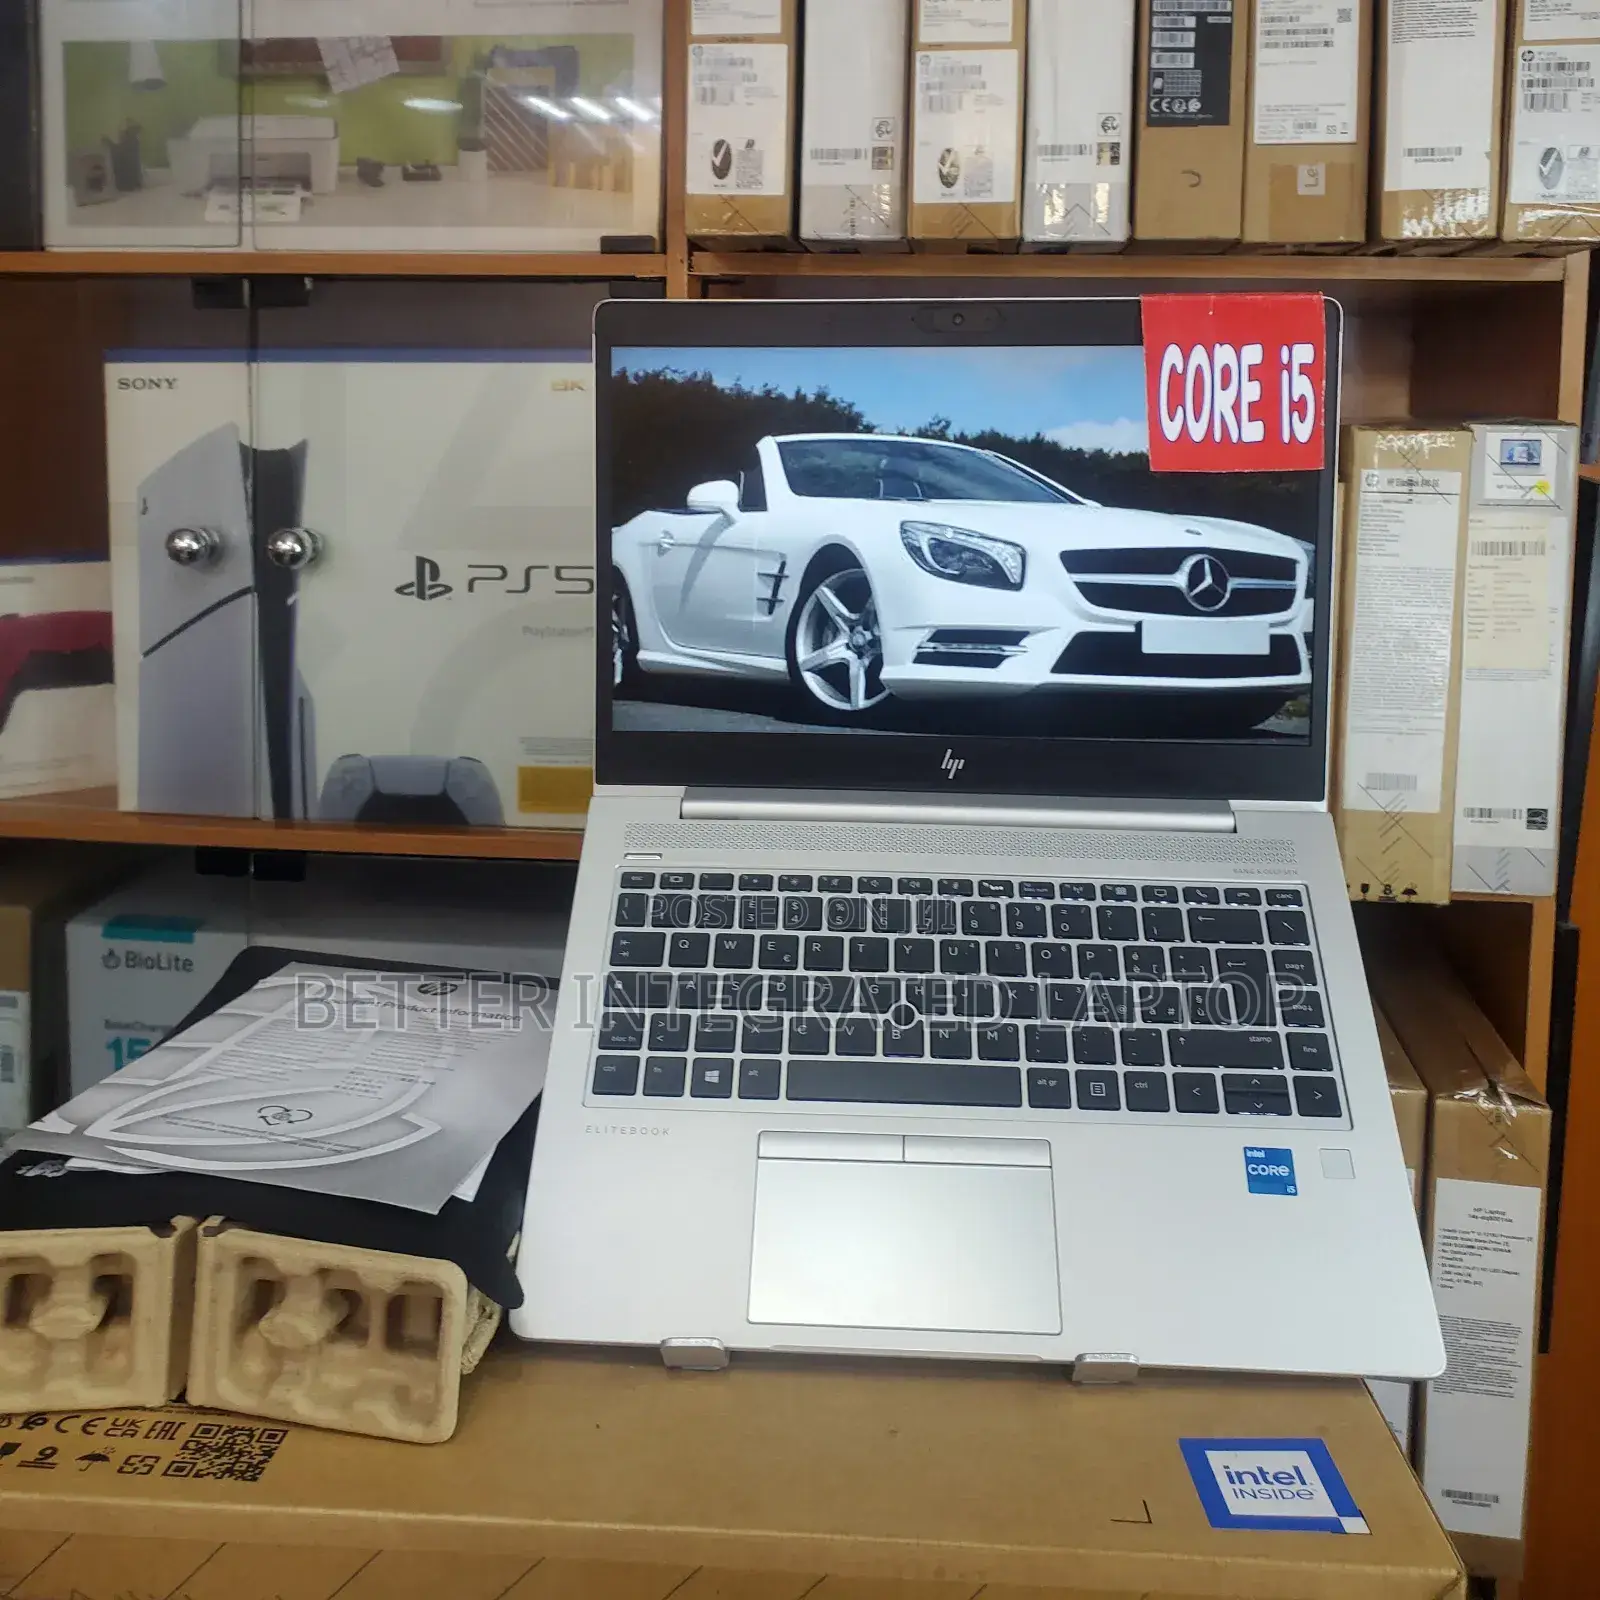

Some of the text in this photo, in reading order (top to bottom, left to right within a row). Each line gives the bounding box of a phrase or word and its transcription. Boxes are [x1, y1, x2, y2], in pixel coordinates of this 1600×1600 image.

[117, 378, 178, 390] SONY
[1159, 343, 1315, 444] CORE i5
[467, 563, 595, 595] PS5
[941, 748, 965, 779] hp
[970, 920, 979, 928] 8
[1015, 921, 1023, 930] 9
[679, 939, 690, 949] Q
[724, 940, 737, 949] W
[767, 941, 776, 951] E
[812, 943, 821, 952] R
[857, 944, 866, 953] T
[903, 945, 912, 954] Y
[948, 947, 958, 956] U
[1041, 949, 1052, 959] O
[1086, 952, 1095, 960] P
[125, 950, 194, 972] BioLite
[686, 981, 696, 989] A
[732, 982, 740, 991] S
[777, 983, 786, 991] D
[869, 985, 879, 993] G
[915, 986, 923, 995] H
[961, 988, 968, 996] J
[1008, 989, 1018, 999] K
[1055, 992, 1063, 1001] L
[440, 1006, 524, 1022] Information
[704, 1023, 713, 1032] Z
[751, 1024, 760, 1034] X
[845, 1026, 855, 1035] V
[892, 1030, 901, 1039] B
[939, 1029, 950, 1038] N
[987, 1031, 998, 1041] M
[1249, 1035, 1272, 1043] stamp
[1134, 1081, 1148, 1089] ctrl
[585, 1125, 670, 1135] ELITEBOOK
[1246, 1149, 1265, 1158] intel
[1287, 1185, 1296, 1193] i5
